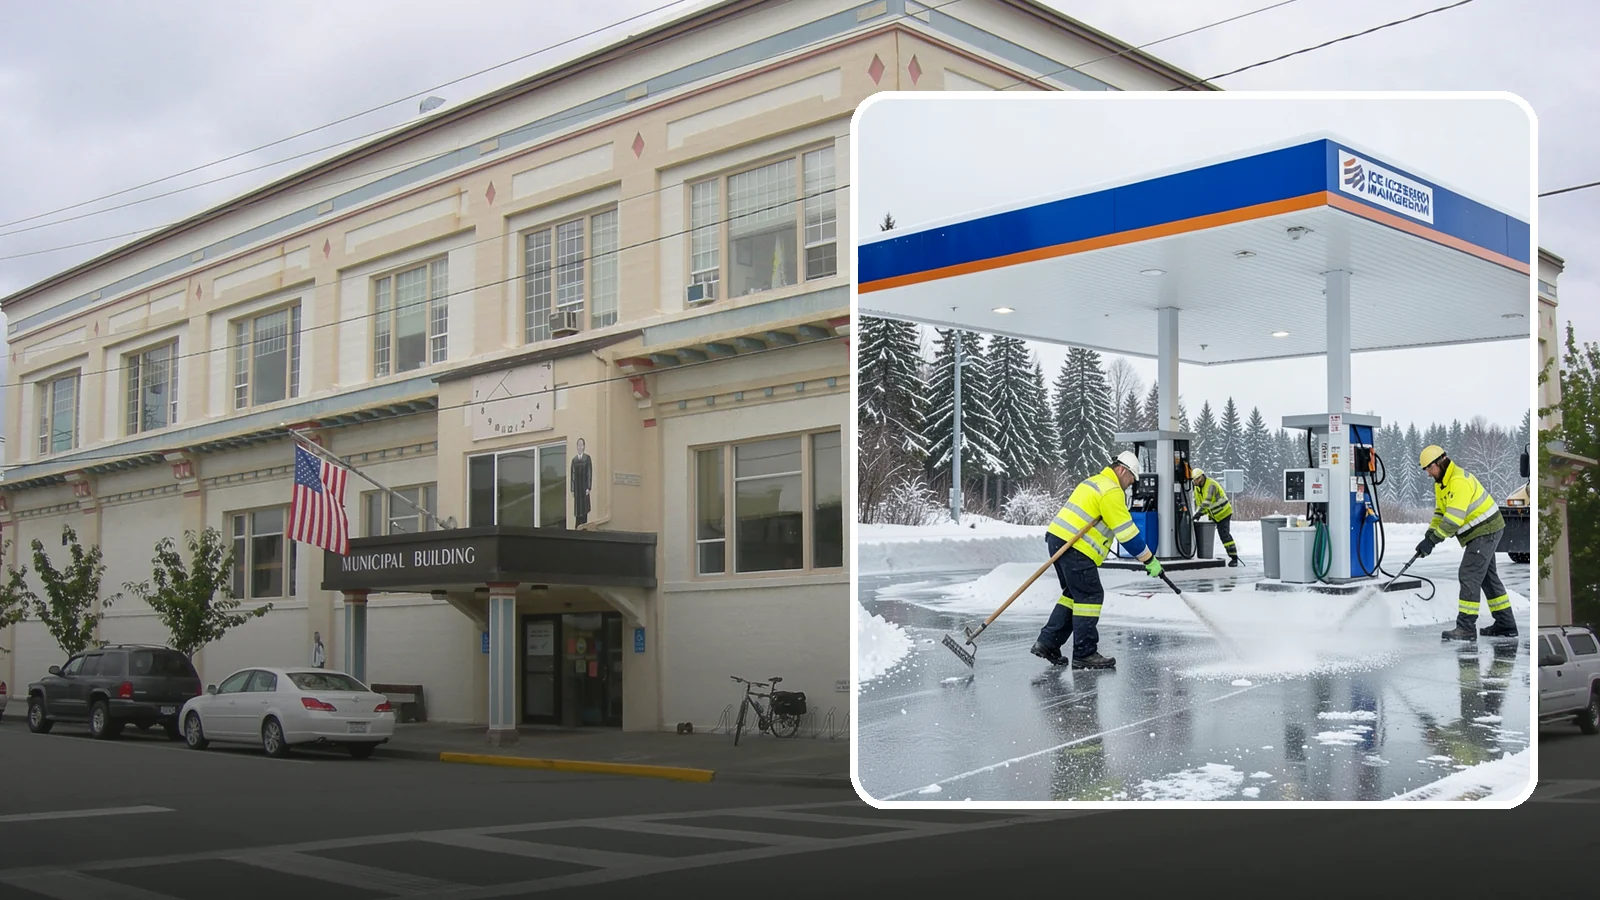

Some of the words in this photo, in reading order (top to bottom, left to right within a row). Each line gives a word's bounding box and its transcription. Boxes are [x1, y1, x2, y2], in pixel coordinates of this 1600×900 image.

[481, 407, 485, 415] 8
[487, 417, 492, 426] 9
[495, 424, 500, 432] 10
[501, 425, 506, 433] 11
[507, 425, 513, 433] 12
[521, 420, 525, 428] 2
[529, 414, 533, 422] 3
[536, 402, 540, 410] 4
[342, 552, 405, 571] MUNICIPAL
[414, 546, 475, 567] BUILDING
